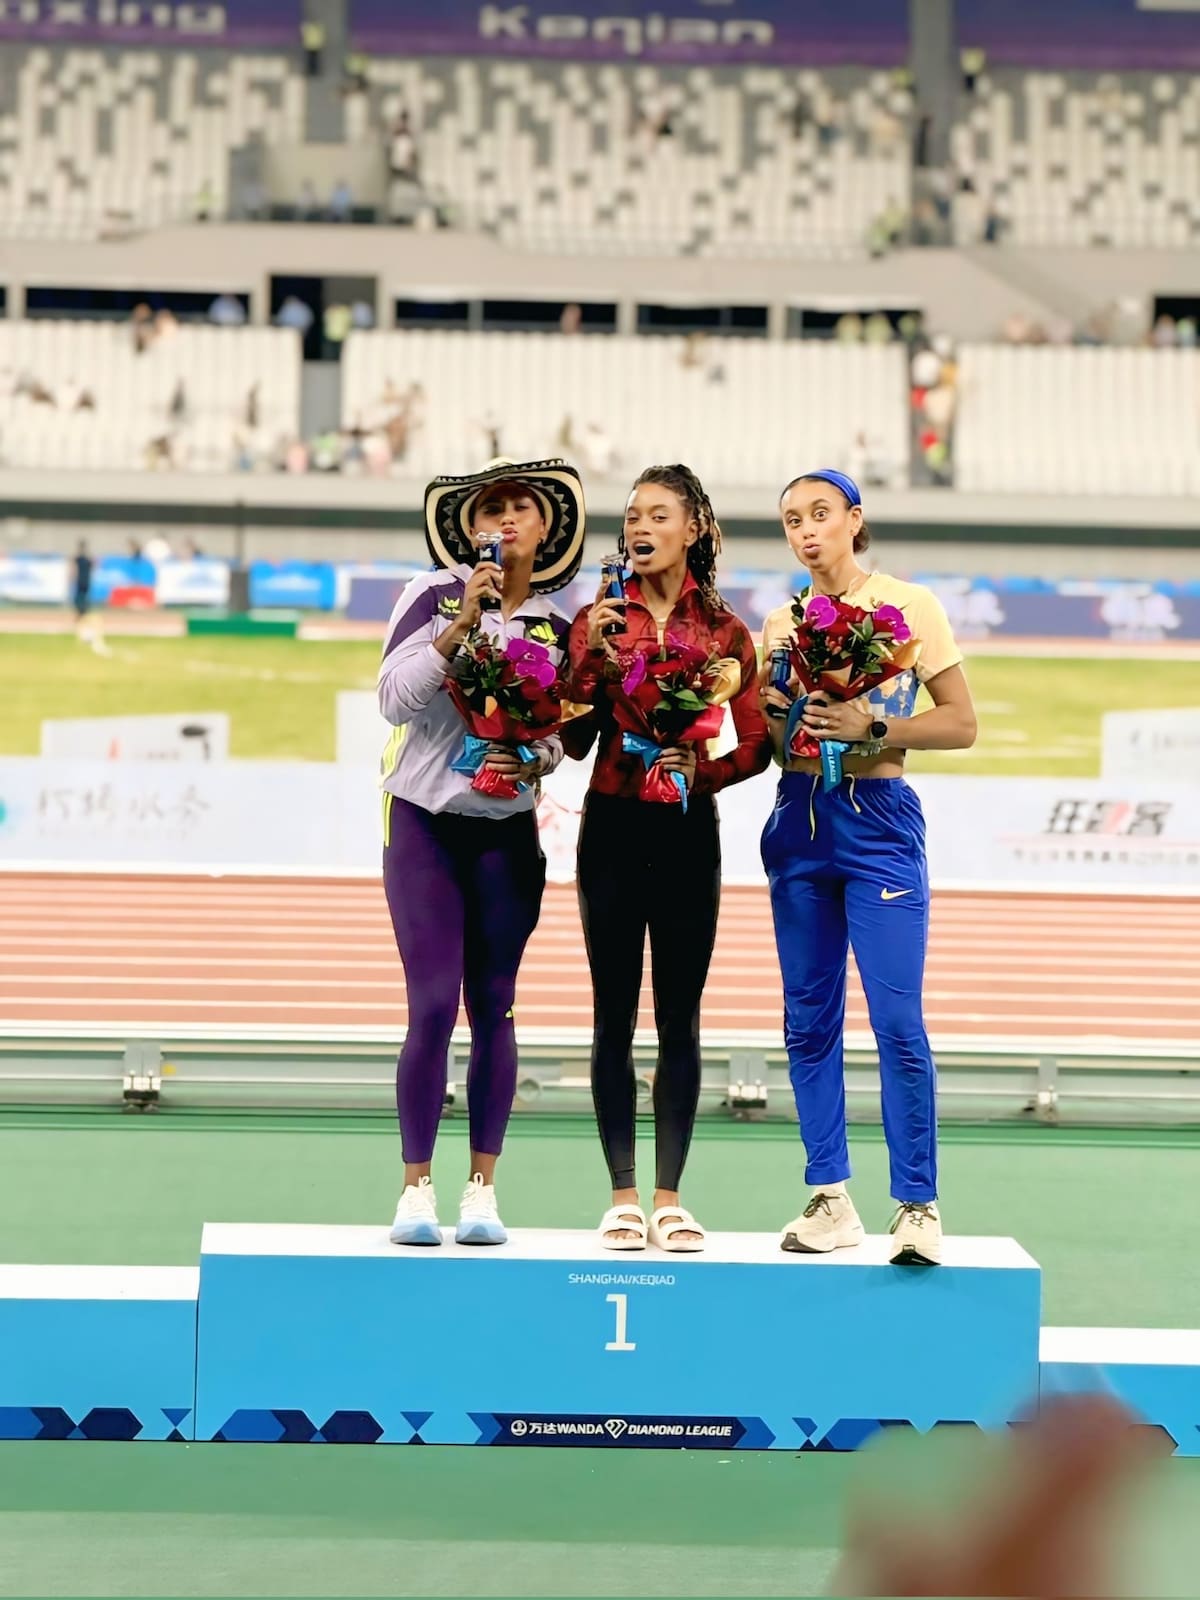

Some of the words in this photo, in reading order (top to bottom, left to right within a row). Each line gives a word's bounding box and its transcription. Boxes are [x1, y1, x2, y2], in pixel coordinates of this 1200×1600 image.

[604, 1293, 637, 1351] 1
[627, 1424, 684, 1436] DIAMOND
[685, 1425, 733, 1437] LEAGUE
